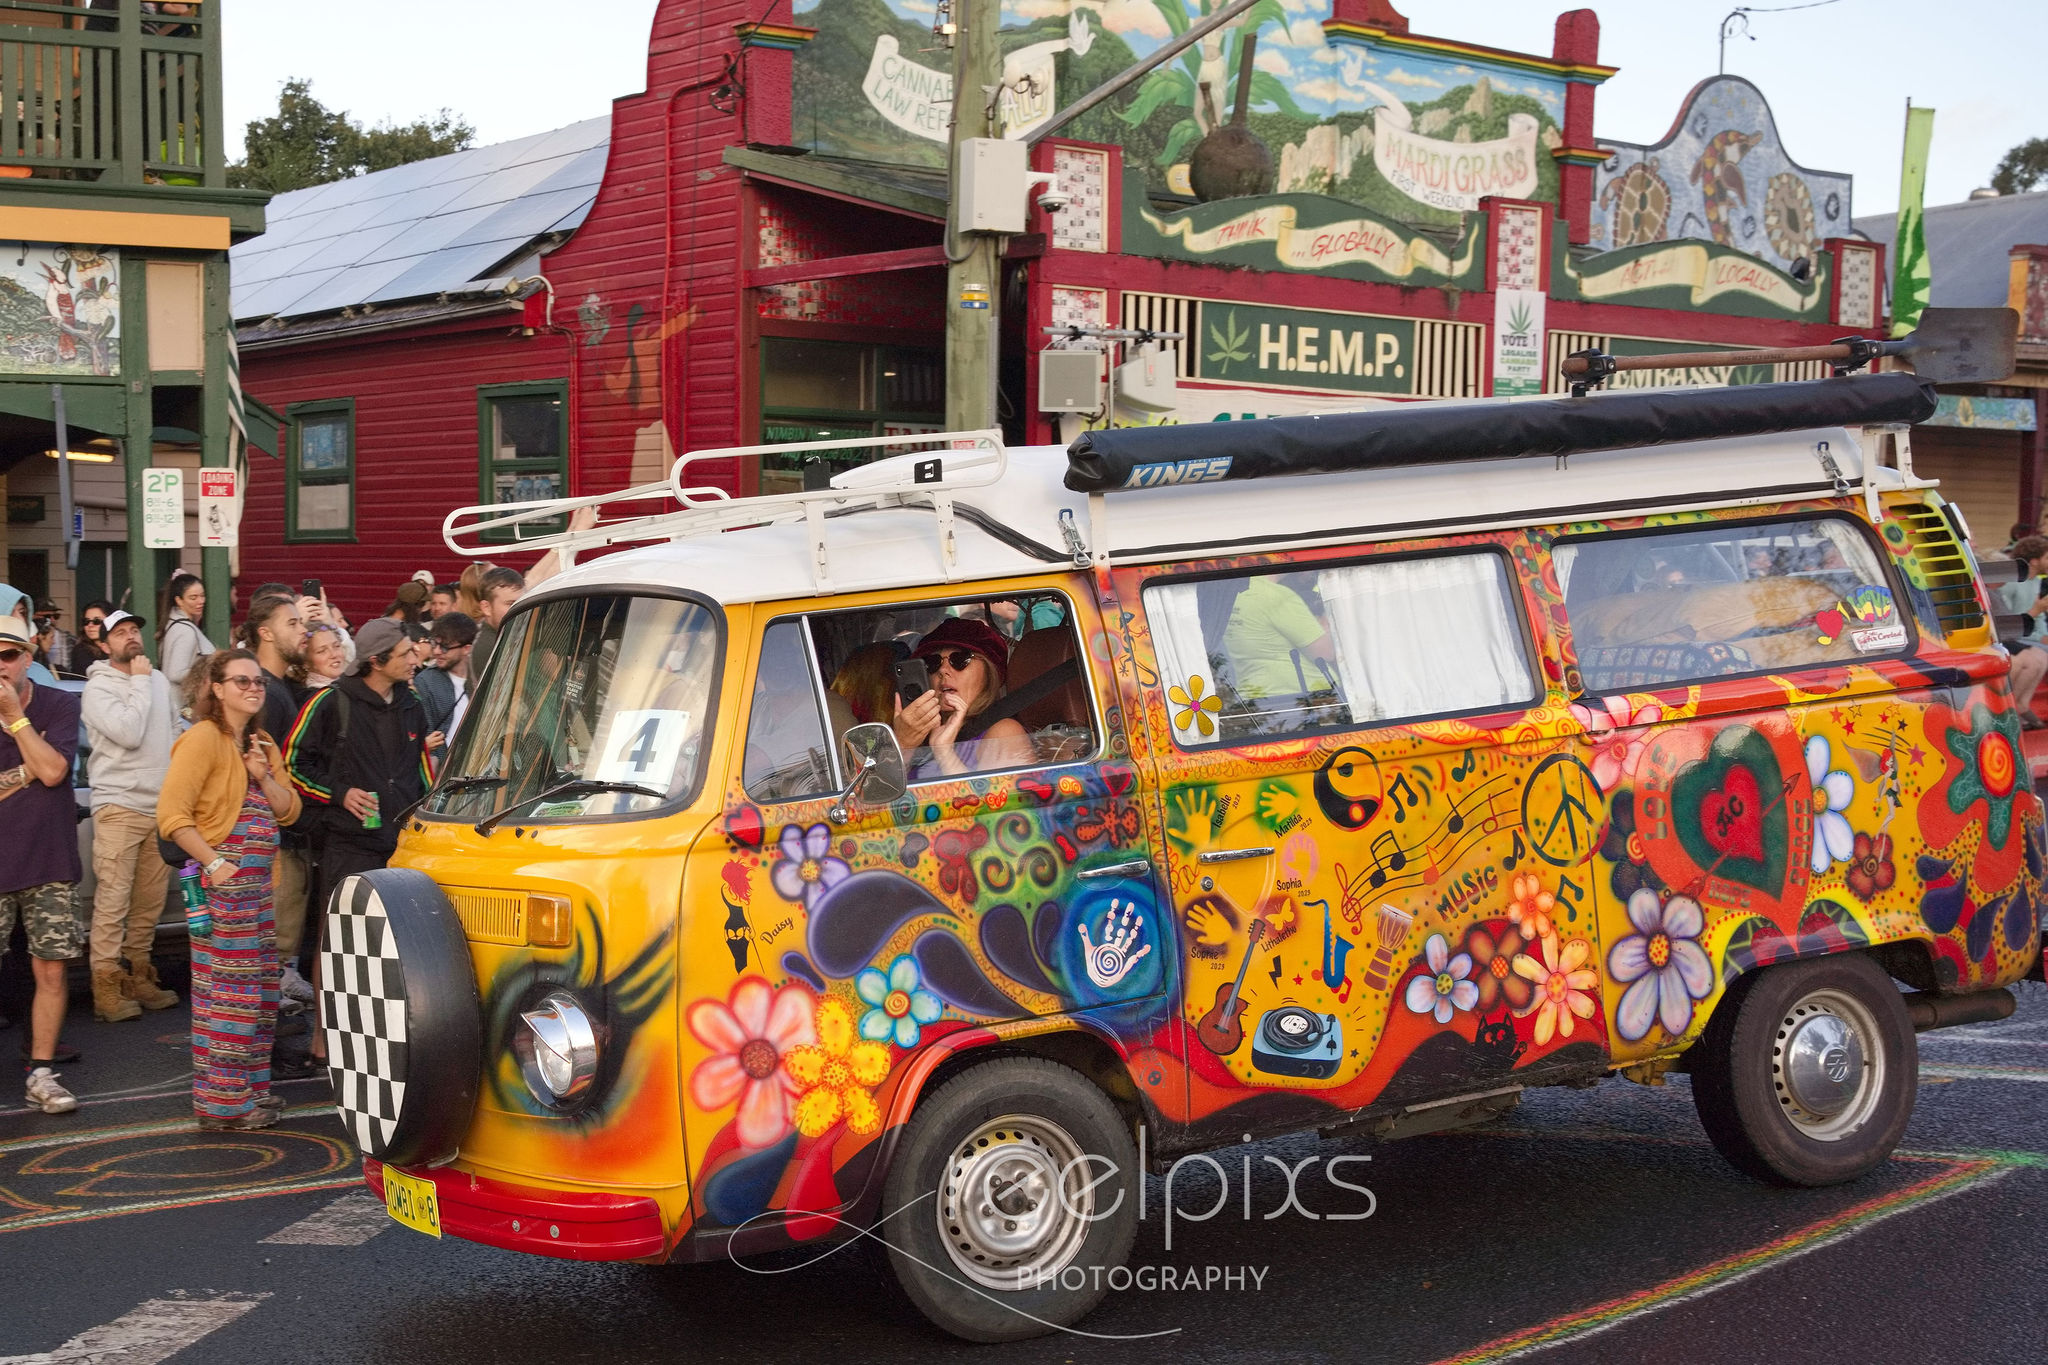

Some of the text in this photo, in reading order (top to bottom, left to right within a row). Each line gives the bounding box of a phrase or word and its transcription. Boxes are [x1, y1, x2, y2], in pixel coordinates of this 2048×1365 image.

[874, 80, 909, 116] LAW
[1386, 132, 1529, 193] MARDI GRASS
[1422, 187, 1465, 210] WEEKEND
[1715, 263, 1780, 291] LOCALLY
[1259, 323, 1405, 379] H.E.M.P.
[1501, 333, 1538, 347] VOTE 1
[148, 474, 179, 492] 2P
[1124, 461, 1230, 488] KINGS
[616, 717, 661, 773] 4
[1642, 743, 1677, 841] LOVE
[1212, 794, 1232, 828] Isabelle
[1273, 813, 1303, 838] Matilda
[1788, 798, 1811, 887] PEACE
[1276, 878, 1303, 892] Sophia
[760, 917, 794, 945] Daisy
